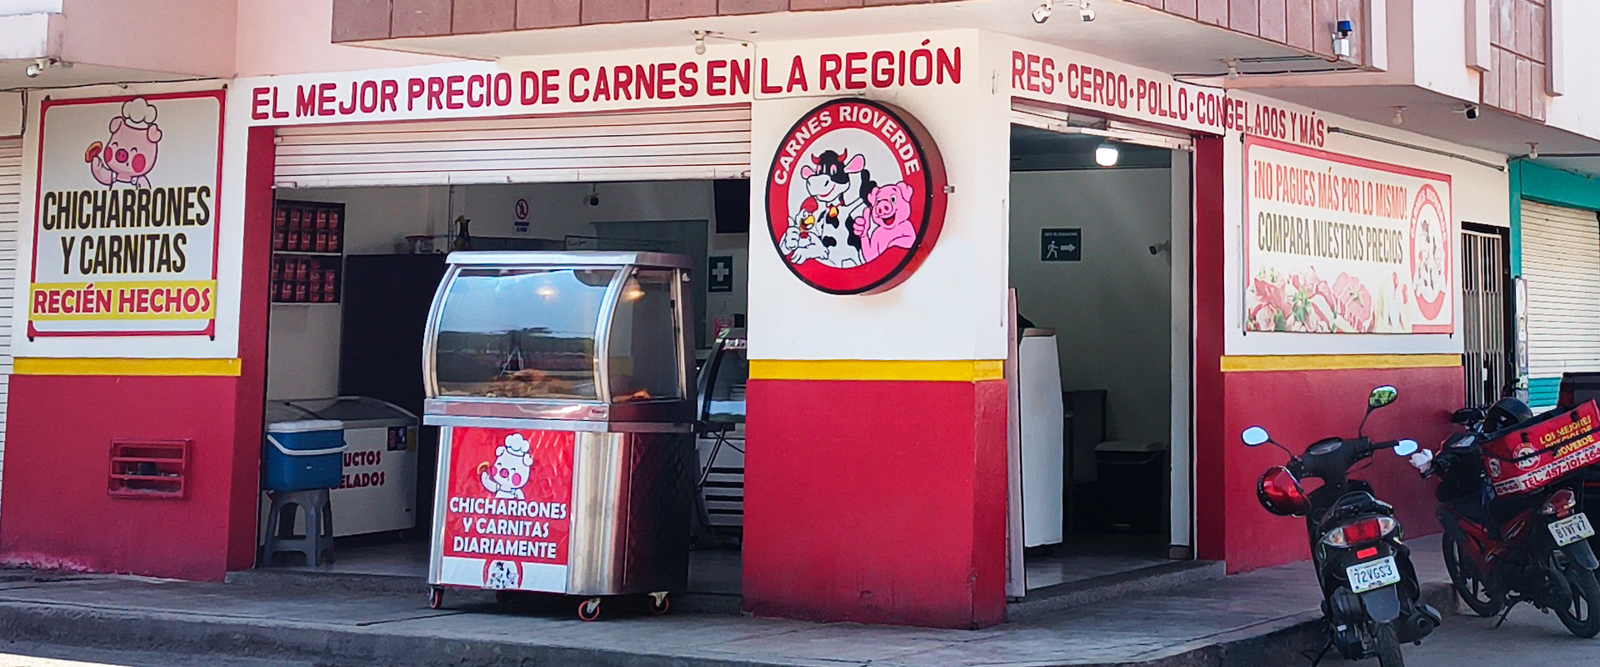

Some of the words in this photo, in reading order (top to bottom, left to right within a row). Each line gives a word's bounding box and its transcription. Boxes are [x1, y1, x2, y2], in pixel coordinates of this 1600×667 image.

[252, 87, 289, 120] EL
[296, 80, 398, 117] MEJOR
[407, 72, 512, 112] PRECIO
[520, 69, 560, 106] DE
[569, 61, 698, 102] CARNES
[706, 58, 750, 96] EN
[760, 55, 808, 94] LA
[819, 39, 961, 90] REGIÓN
[1012, 50, 1055, 95] RES
[1067, 63, 1127, 109] CERDO
[1137, 78, 1187, 121] POLLO
[1197, 91, 1286, 139] CONGELADOS
[1290, 111, 1297, 142] Y
[1300, 111, 1324, 148] MÁS
[774, 111, 832, 185] CARNES
[839, 106, 920, 175] RIOVERDE
[42, 185, 211, 230] CHICHARRONES
[1254, 159, 1273, 201] ¡NO
[1276, 164, 1315, 208] PAGUES
[1318, 167, 1339, 211] MÁS
[1341, 176, 1360, 214] POR
[1362, 180, 1373, 216] LO
[1375, 182, 1408, 220] MISMO!
[61, 236, 75, 274] Y
[79, 233, 187, 275] CARNITAS
[1257, 211, 1311, 256] COMPARA
[1313, 219, 1364, 261] NUESTROS
[1366, 226, 1403, 265] PRECIOS
[33, 283, 112, 314] RECIÉN
[118, 287, 211, 313] HECHOS
[1539, 432, 1556, 445] LOS
[344, 450, 381, 467] UCTOS
[330, 471, 385, 490] ELADOS
[449, 497, 567, 519] CHICHARRONES
[463, 517, 473, 532] Y
[476, 518, 549, 538] CARNITAS
[453, 536, 557, 559] DIARIAMENTE
